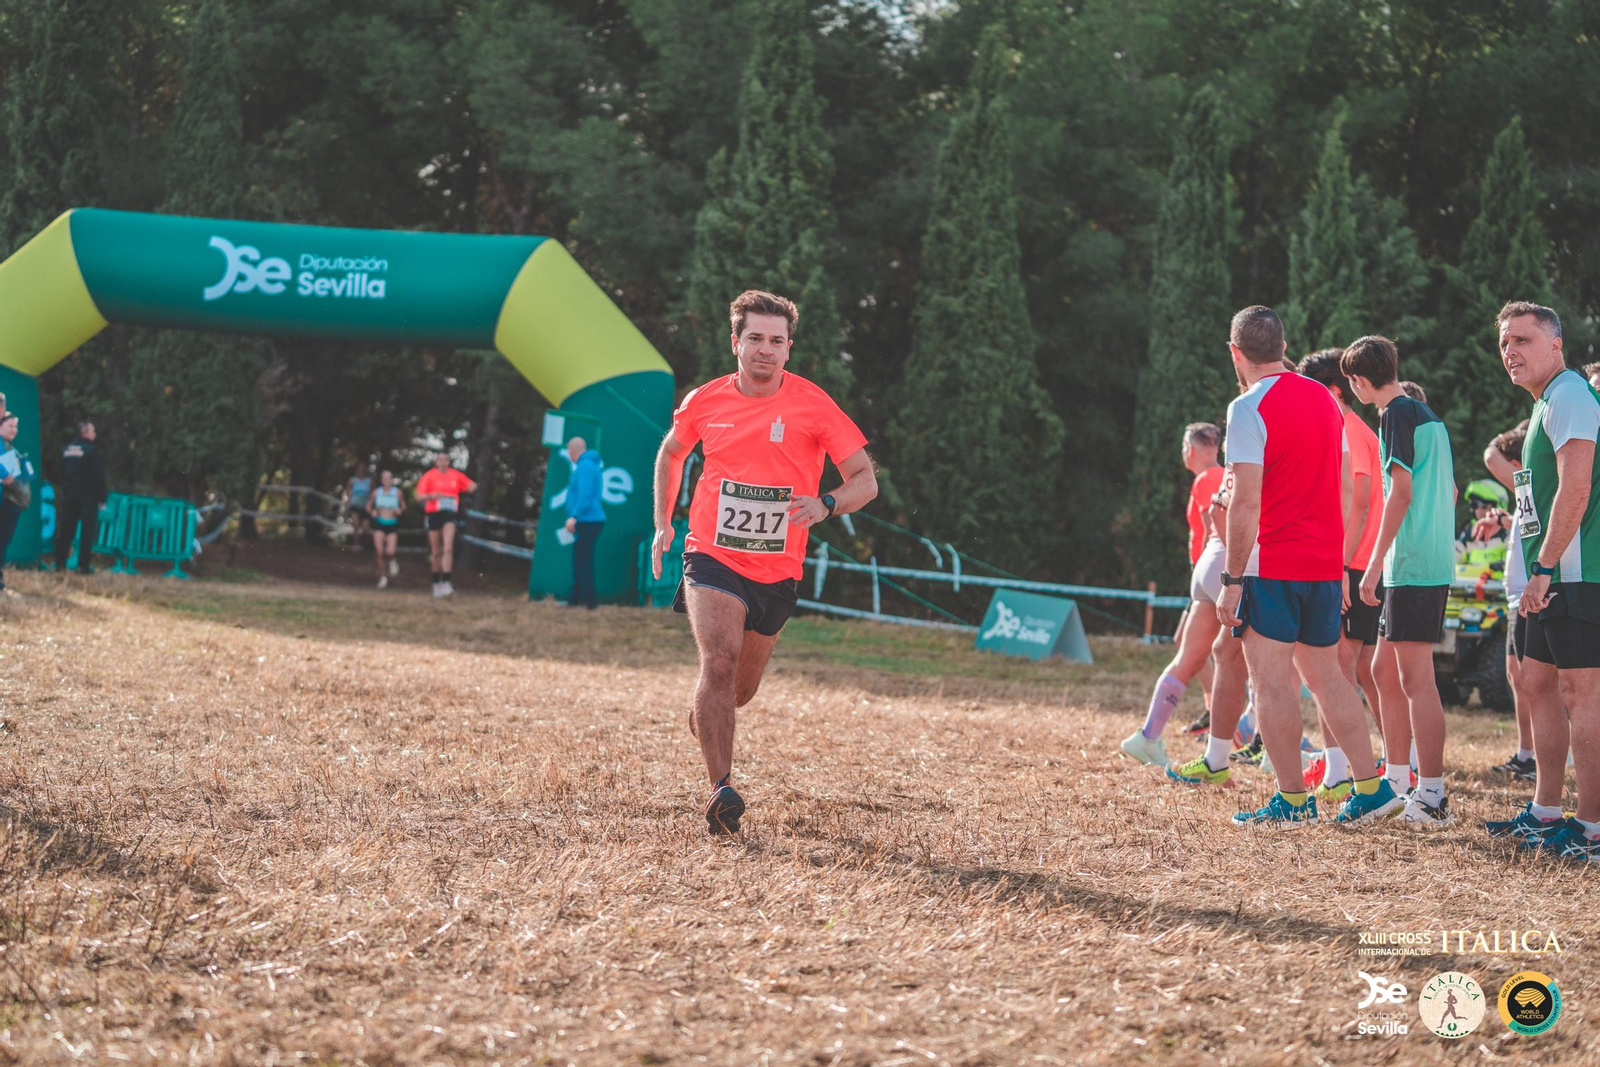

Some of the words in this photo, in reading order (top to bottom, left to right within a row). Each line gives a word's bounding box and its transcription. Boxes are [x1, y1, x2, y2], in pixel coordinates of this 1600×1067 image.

[299, 253, 388, 271] Diputación
[297, 272, 386, 299] Sevilla
[739, 486, 775, 498] ITÁLICA
[723, 507, 785, 534] 2217
